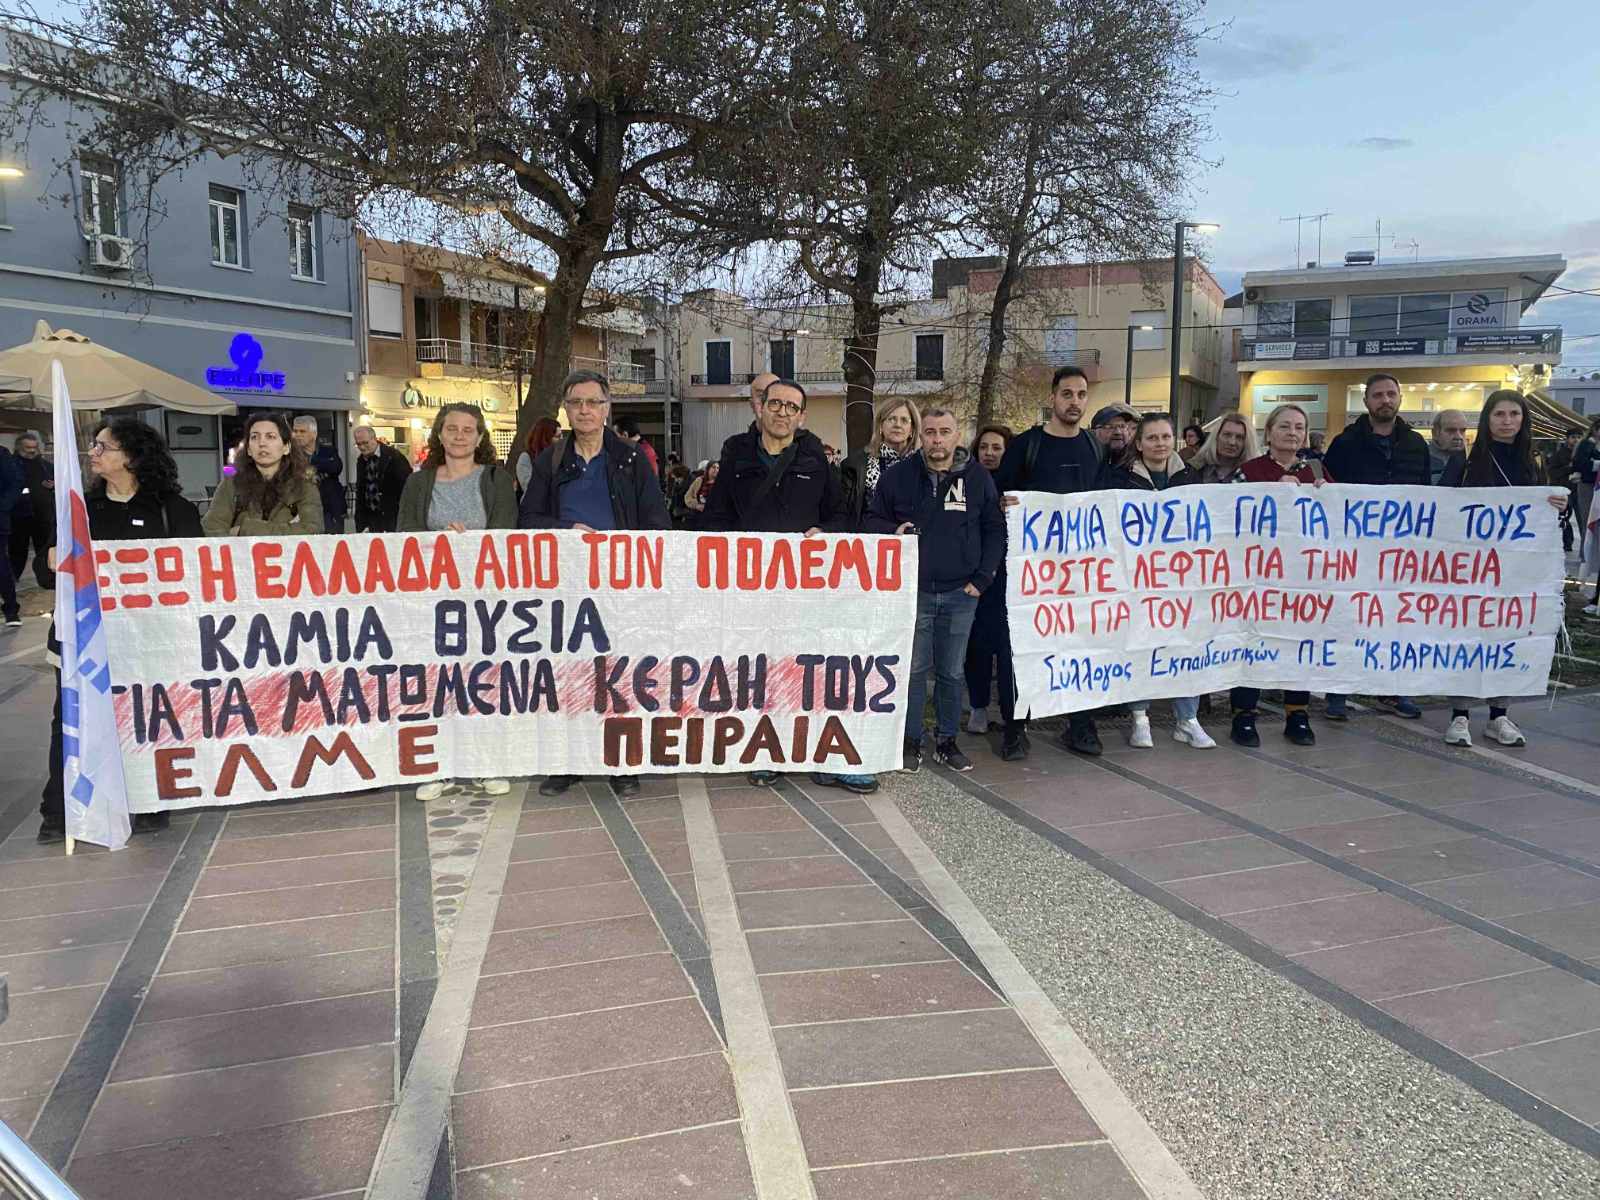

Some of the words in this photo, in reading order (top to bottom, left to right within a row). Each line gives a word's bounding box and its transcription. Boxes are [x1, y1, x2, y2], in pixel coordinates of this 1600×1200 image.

[1457, 316, 1498, 326] ORAMA
[1022, 503, 1107, 553] ΚΑΜΙΑ
[1121, 499, 1212, 546] ΘΥΣΙΑ
[1235, 495, 1278, 538] ΓΙΑ
[1294, 497, 1329, 539] ΤΑ
[1344, 499, 1436, 539] ΚΕΡΔΗ
[1460, 504, 1535, 541] ΤΟΥΣ
[200, 544, 237, 601] Η
[251, 534, 461, 599] ΕΛΛΑΔΑ
[474, 533, 559, 590] ΑΠΟ
[582, 533, 664, 590] ΤΟΝ
[696, 536, 902, 591] ΠΟΛΕΜΟ
[1021, 556, 1117, 596] ΔΩΣΤΕ
[1134, 549, 1230, 589] ΛΕΦΤΑ
[1245, 545, 1284, 579] ΓΙΑ
[1301, 548, 1357, 581] ΤΗΝ
[1378, 547, 1501, 586] ΠΑΙΔΕΙΑ
[200, 605, 394, 672] ΚΑΜΙΑ
[435, 598, 611, 657] ΘΥΣΙΑ
[1034, 602, 1075, 637] ΟΧΙ
[1090, 600, 1130, 635] ΓΙΑ
[1141, 596, 1193, 629] ΤΟΥ
[1211, 589, 1334, 624] ΠΟΛΕΜΟΥ
[1350, 591, 1384, 627] ΤΑ
[1397, 591, 1538, 636] ΣΦΑΓΕΙΑ!
[1044, 655, 1132, 692] Σύλλογος
[1150, 640, 1280, 677] Εκπαιδευτικών
[1298, 639, 1337, 667] Π.Ε
[190, 677, 259, 739] ΤΑ
[282, 659, 560, 732] ΜΑΤΩΜΕΝΑ
[593, 654, 767, 714] ΚΕΡΔΗ
[796, 654, 900, 714] ΤΟΥΣ
[154, 725, 439, 800] ΕΛΜΕ
[603, 715, 863, 767] ΠΕΙΡΑΙΑ
